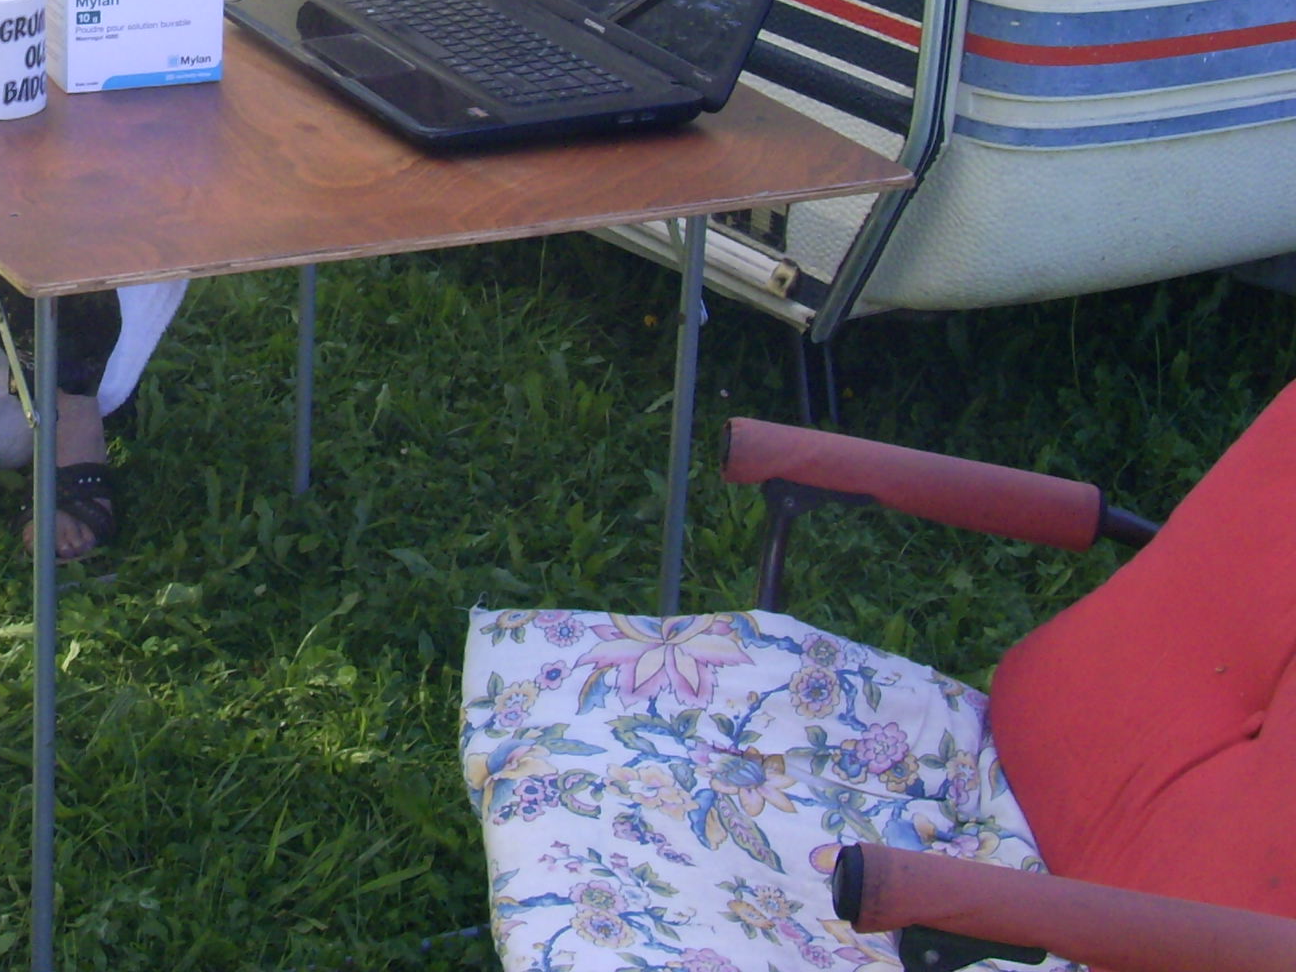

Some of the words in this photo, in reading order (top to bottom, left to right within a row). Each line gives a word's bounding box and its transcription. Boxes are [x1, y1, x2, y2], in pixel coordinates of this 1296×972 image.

[78, 12, 91, 23] 10
[25, 40, 45, 69] OL
[180, 55, 212, 66] Mylan
